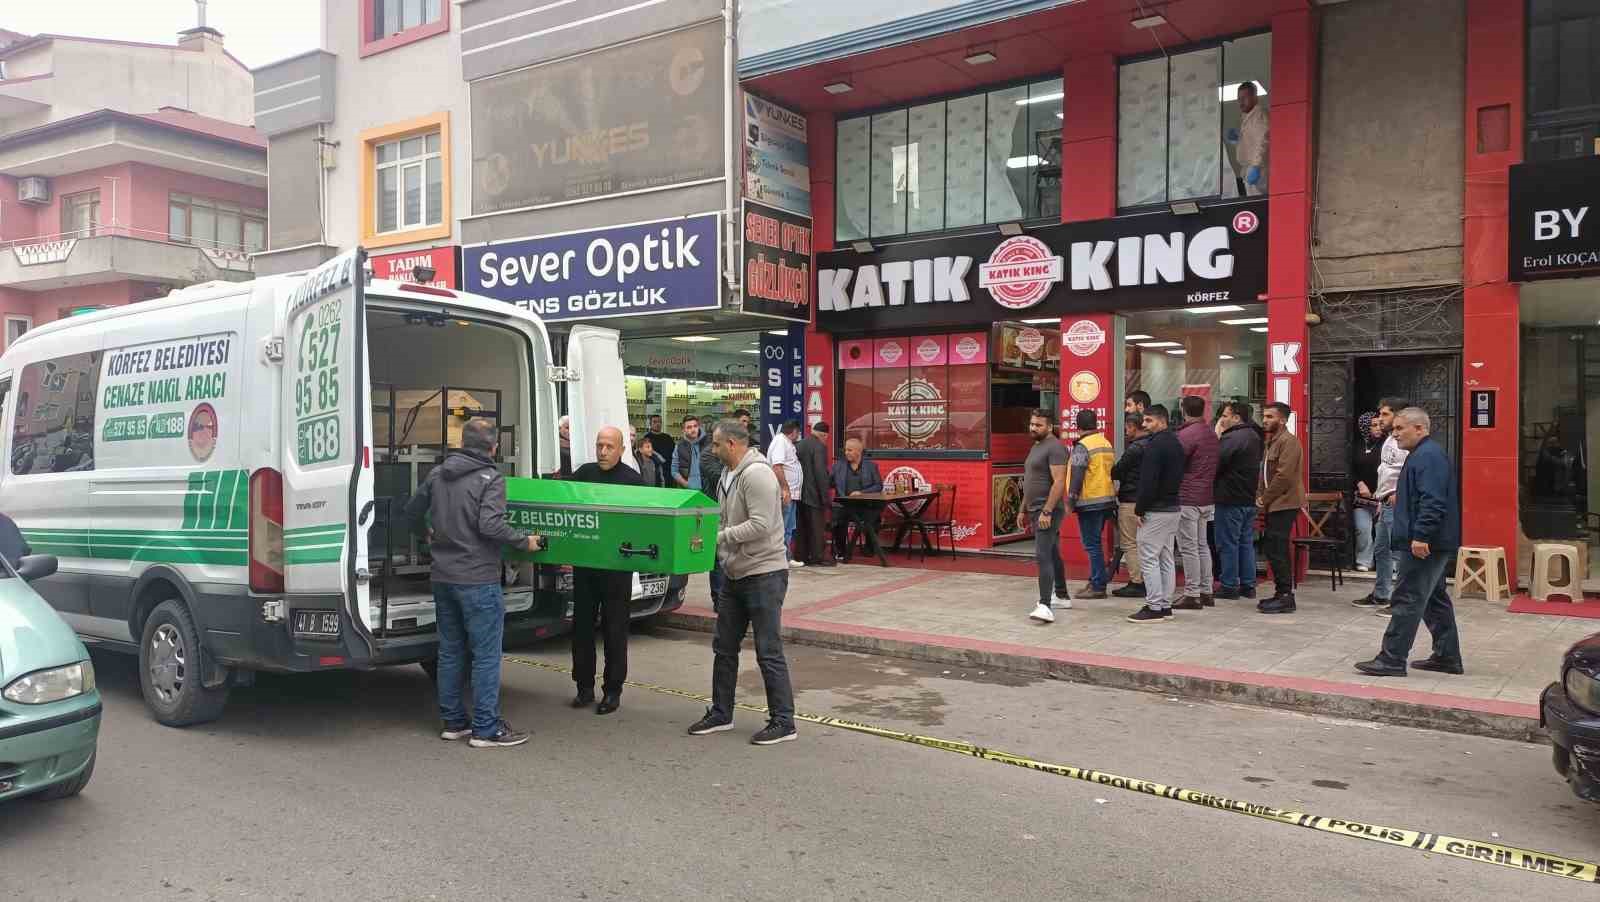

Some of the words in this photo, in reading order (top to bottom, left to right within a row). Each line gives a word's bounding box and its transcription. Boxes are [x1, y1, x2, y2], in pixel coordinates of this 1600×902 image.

[746, 211, 779, 248] SEVER
[1534, 206, 1589, 240] BY
[388, 255, 432, 272] TADIM
[480, 250, 576, 289] Sever
[586, 227, 700, 283] Optik
[818, 256, 973, 312] KATIK
[1071, 226, 1234, 291] KING
[989, 268, 1020, 280] KATIK
[1023, 265, 1049, 277] KING
[1523, 254, 1552, 268] Erol
[1557, 251, 1600, 266] KOÇA
[748, 252, 808, 309] GÖZLÜKÇÜ
[515, 297, 560, 314] ENS
[567, 286, 667, 312] GÖZLÜK
[1187, 291, 1230, 303] KÖRFEZ
[319, 299, 341, 328] 0262
[107, 347, 153, 377] KÖRFEZ
[153, 332, 231, 371] BELEDİYESİ
[308, 322, 341, 372] 527
[103, 382, 145, 410] CENAZE
[185, 371, 226, 401] ARACI
[295, 374, 312, 417] 95
[319, 366, 339, 410] 85
[793, 347, 802, 413] LENS
[167, 416, 184, 434] 188
[887, 405, 918, 416] KATIK
[919, 404, 945, 416] KING
[304, 418, 339, 461] 188
[521, 509, 600, 529] BELEDİYESİ
[650, 581, 665, 594] 238
[298, 614, 306, 631] 41
[321, 614, 339, 632] 1599
